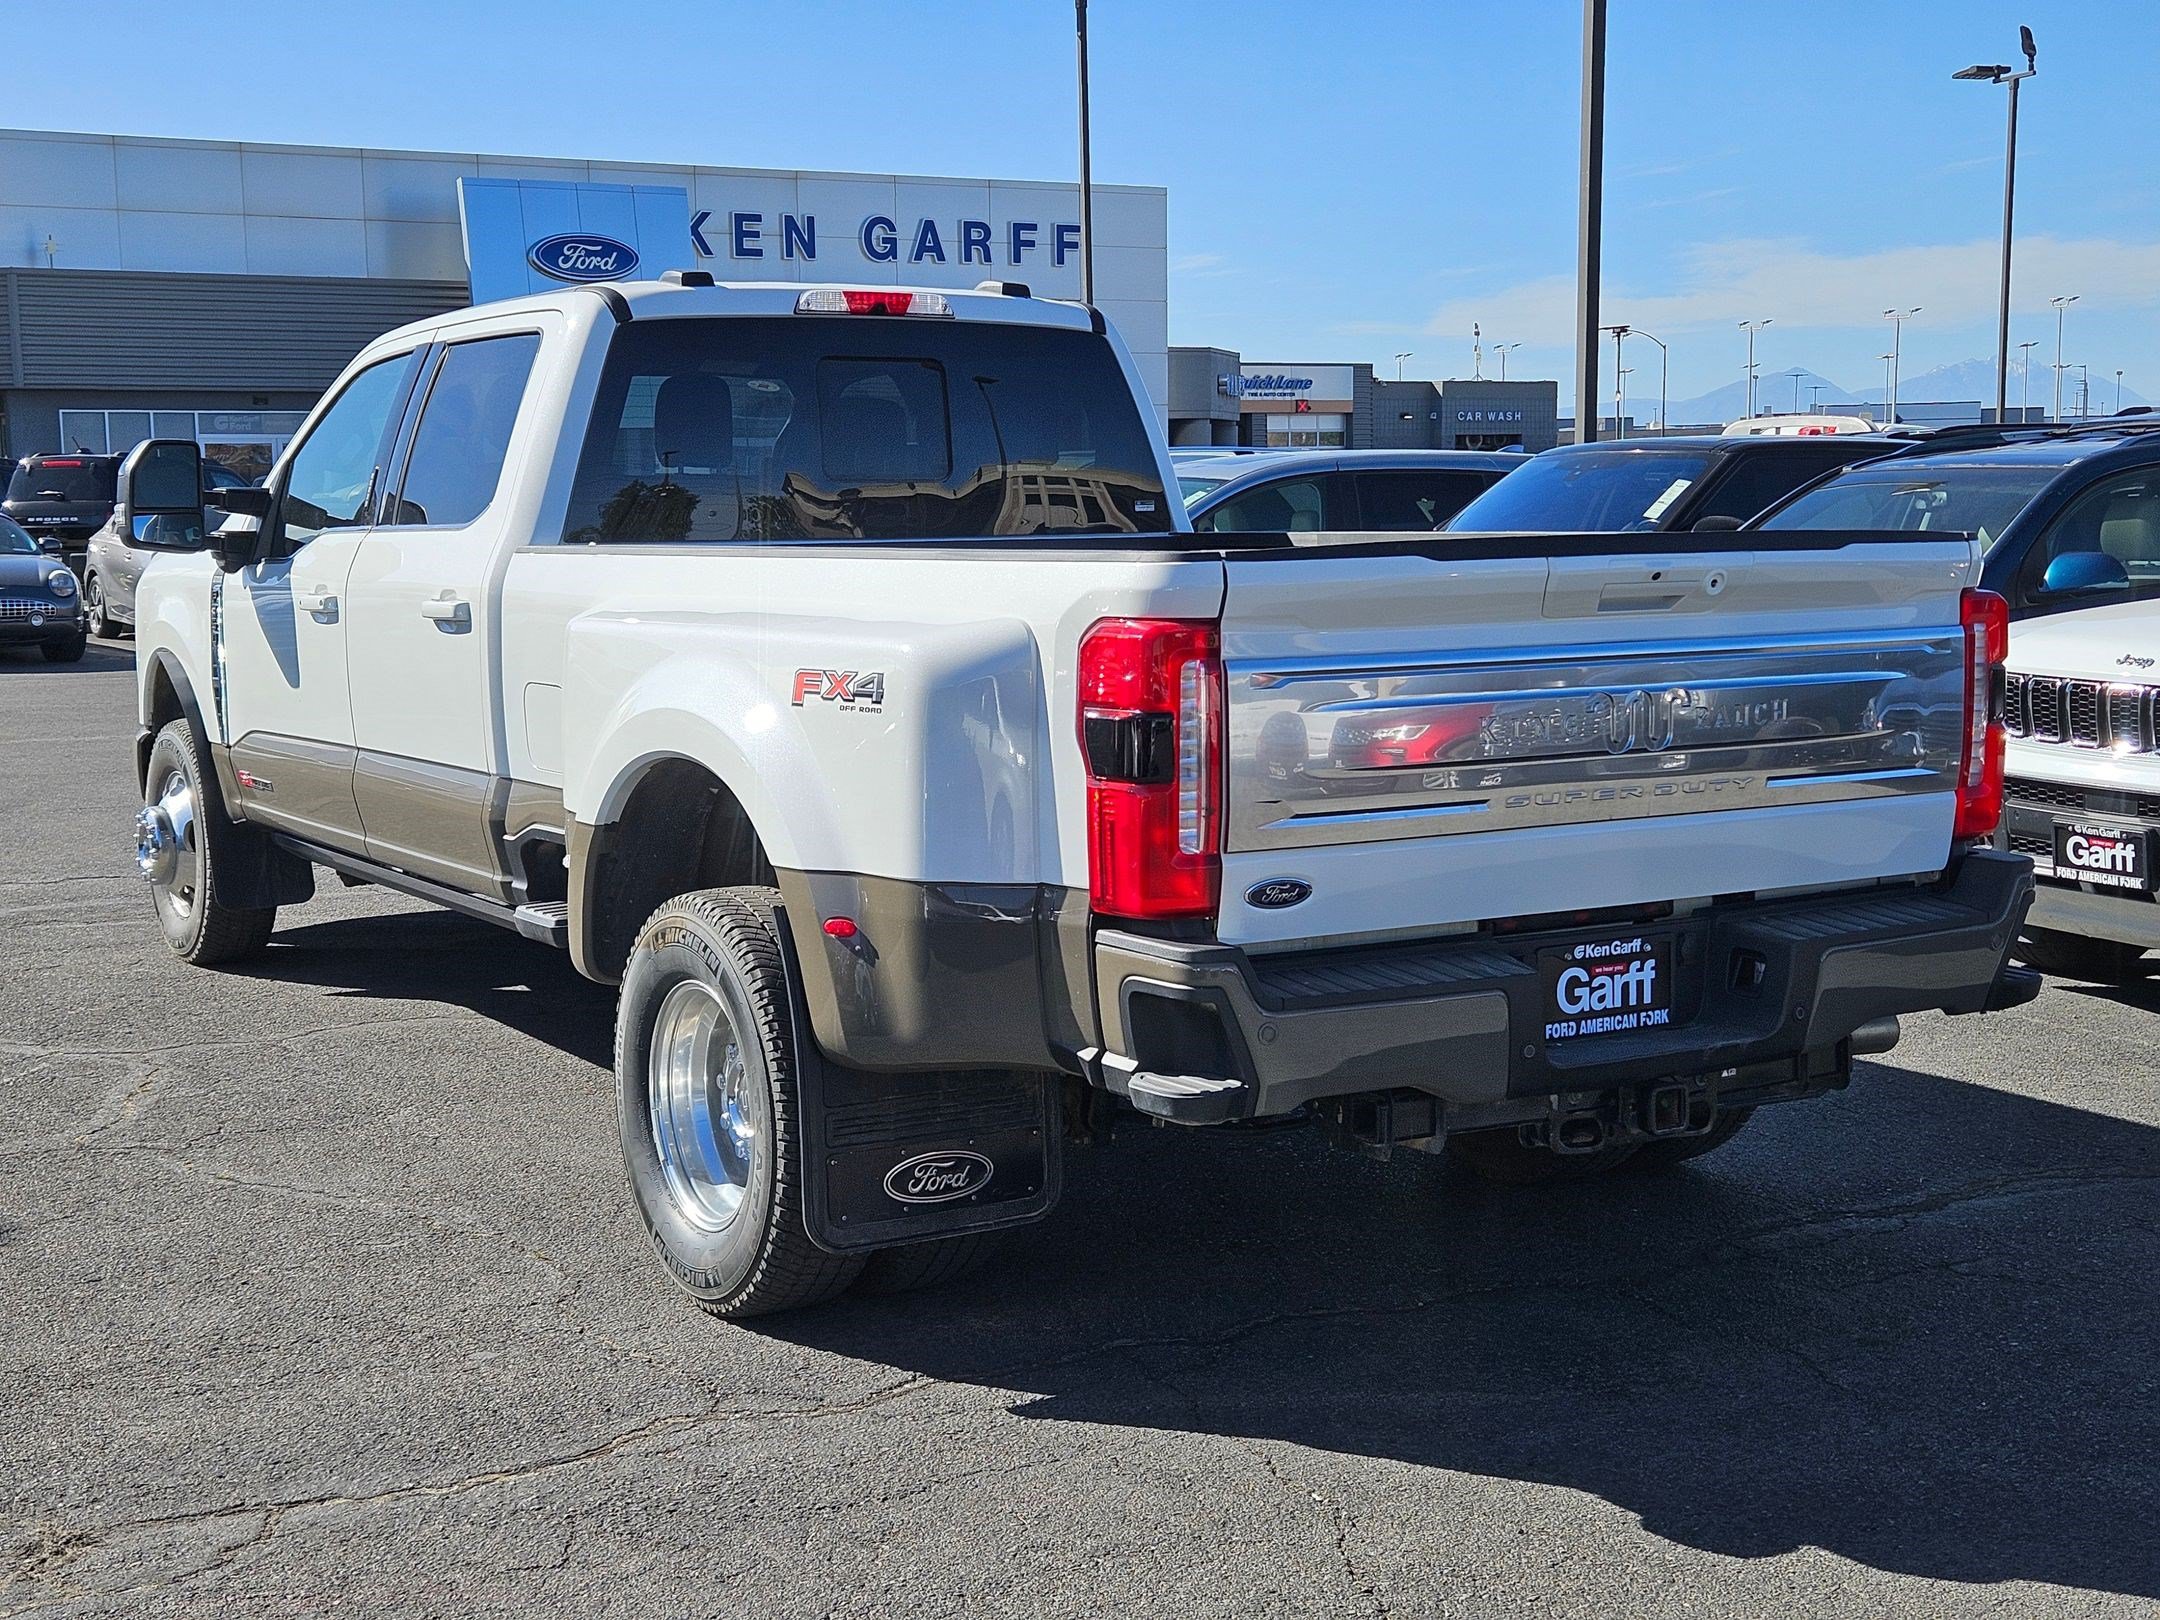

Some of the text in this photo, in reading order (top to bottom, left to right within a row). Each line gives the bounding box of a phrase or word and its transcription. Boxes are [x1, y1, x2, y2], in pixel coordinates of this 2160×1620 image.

[558, 243, 617, 271] Ford
[859, 215, 1081, 267] GARFF
[1457, 411, 1521, 421] CAR WASH
[2116, 653, 2155, 669] Jeep
[792, 668, 884, 706] FX4
[839, 704, 882, 714] OFF ROAD
[1478, 698, 1789, 742] KING RANCH
[2066, 835, 2135, 873] Garff
[1262, 884, 1299, 903] Ford
[2056, 866, 2145, 890] FORD AMERICAN FORK
[665, 926, 721, 973] MICHELIN
[1556, 958, 1656, 1014] Garff
[1545, 1009, 1670, 1039] FORD AMERICAN FORK
[908, 1160, 970, 1193] Ford
[654, 1236, 706, 1288] MICHELIN
